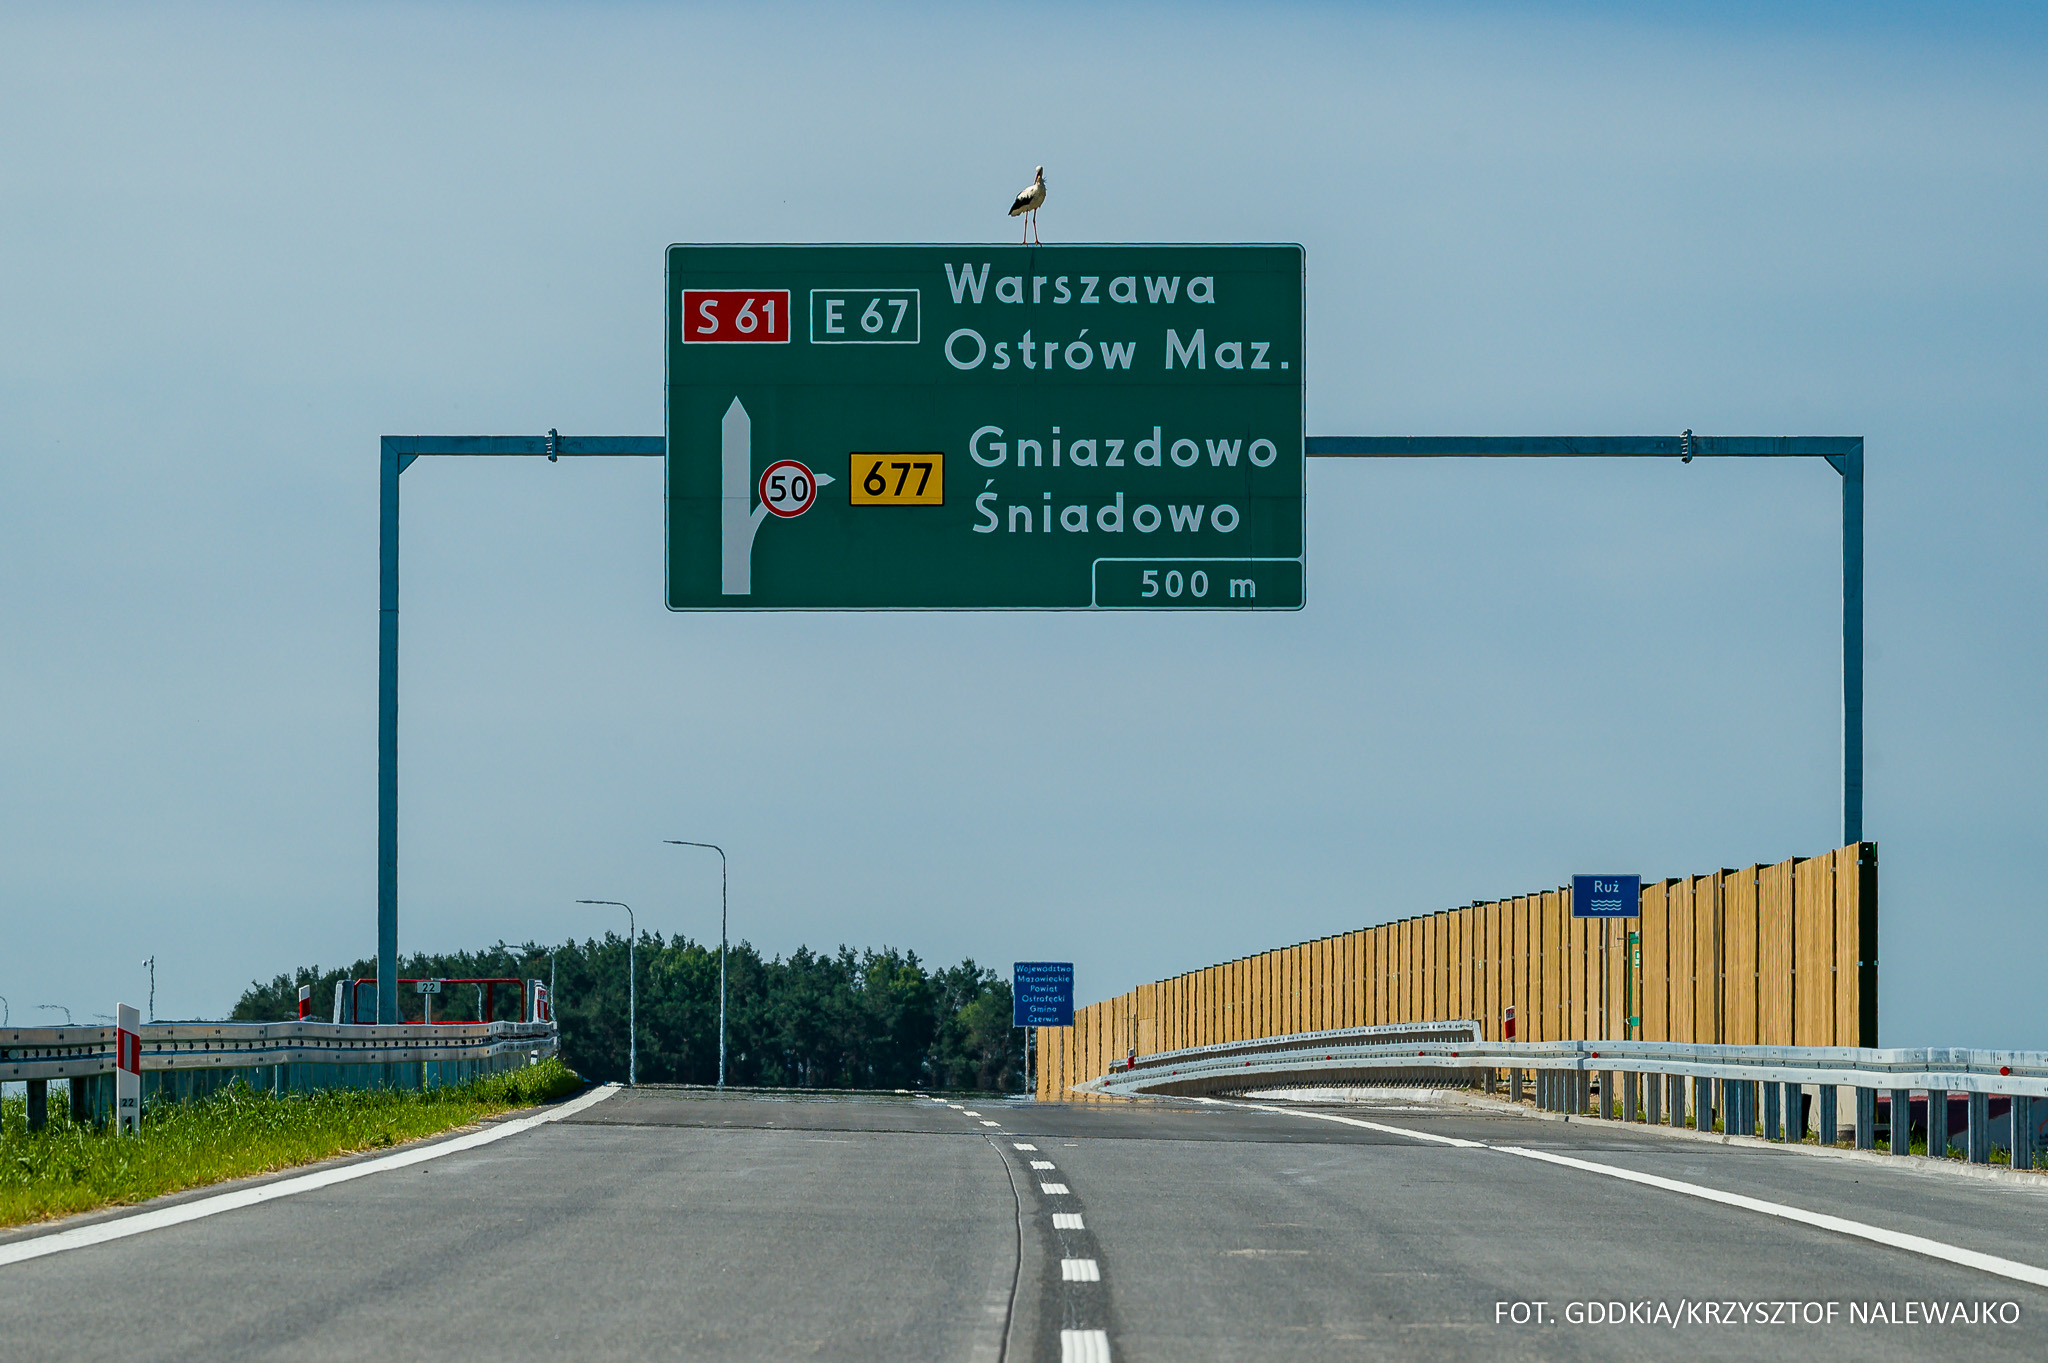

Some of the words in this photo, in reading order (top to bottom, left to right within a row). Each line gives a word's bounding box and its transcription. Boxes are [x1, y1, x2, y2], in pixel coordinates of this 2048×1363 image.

[944, 263, 1215, 304] Warszawa
[696, 299, 719, 334] S
[735, 298, 775, 334] 61
[826, 299, 845, 334] E
[861, 298, 908, 334] 67
[944, 328, 1136, 370] Ostrów
[1165, 328, 1290, 370] Maz.
[969, 425, 1277, 467] Gniazdowo
[769, 475, 808, 502] 50
[863, 461, 933, 497] 677
[972, 479, 1240, 533] Śniadowo
[1141, 570, 1209, 598] 500
[1230, 579, 1256, 598] m
[1594, 880, 1619, 893] Ruż
[1016, 965, 1071, 974] Województwo
[1017, 975, 1070, 983] Mazowieckie
[422, 982, 435, 992] 22
[122, 1098, 134, 1107] 22
